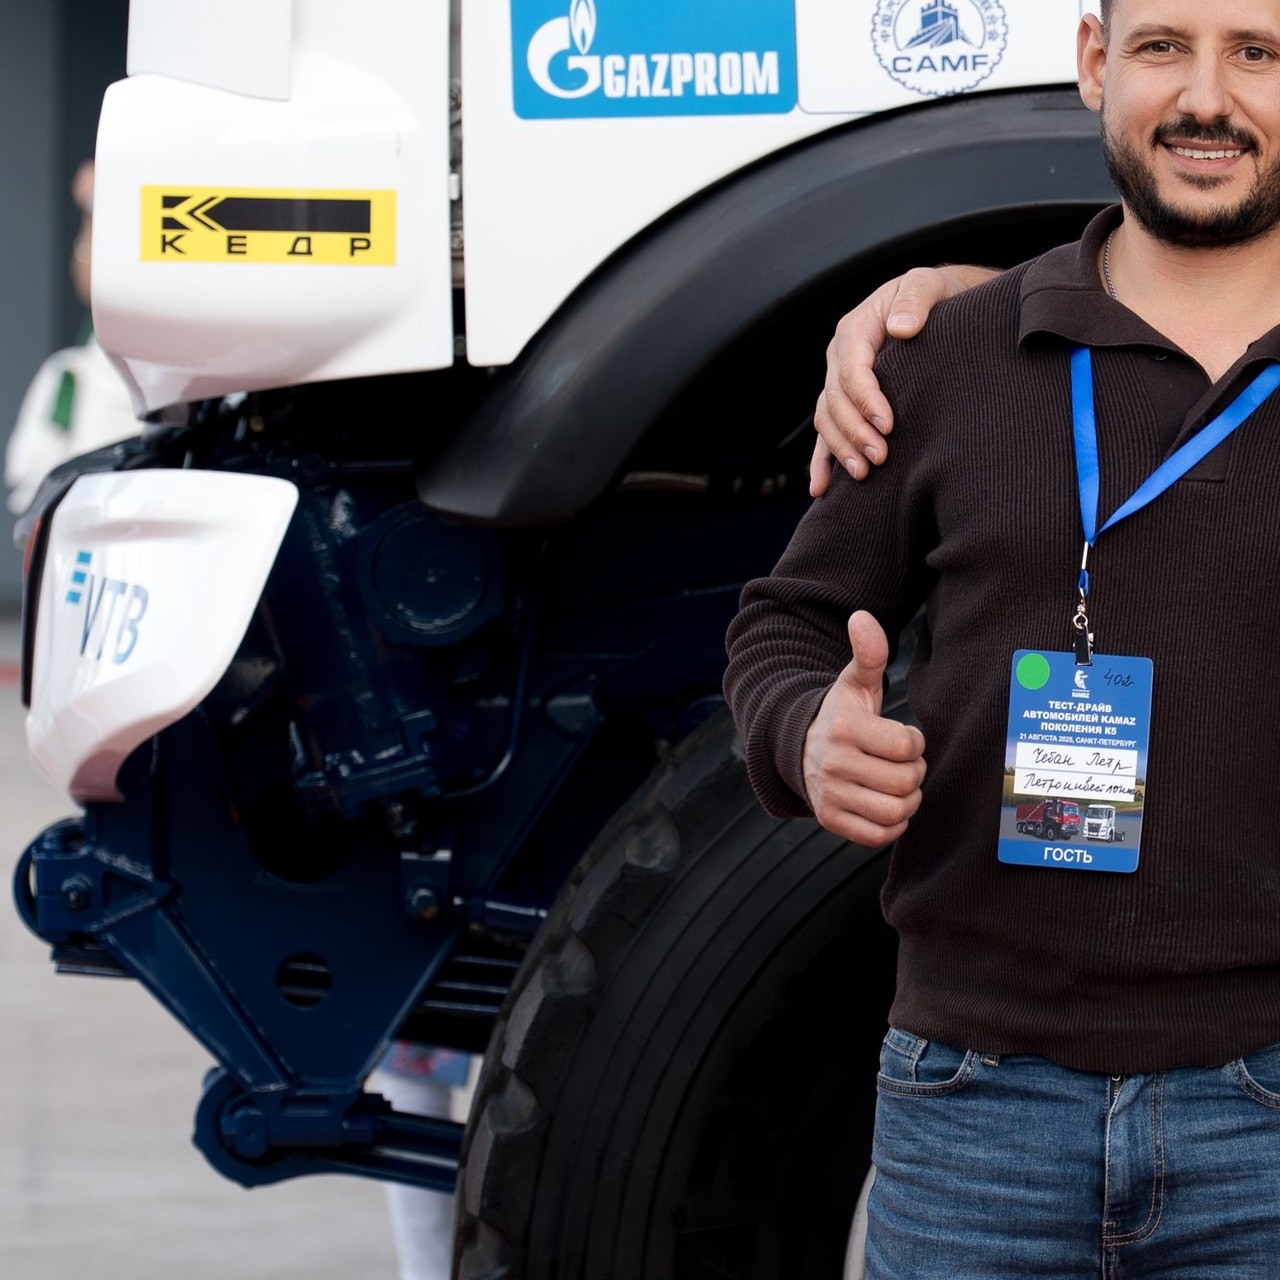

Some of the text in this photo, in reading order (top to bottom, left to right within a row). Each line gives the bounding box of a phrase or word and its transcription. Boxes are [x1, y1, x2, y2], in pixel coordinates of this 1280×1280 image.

[892, 54, 989, 73] CAMF
[602, 51, 779, 99] GAZPROM
[161, 234, 371, 257] КЕДР
[80, 574, 149, 665] VTB
[1048, 700, 1112, 713] ТЕСТ-ДРАЙВ
[1023, 710, 1099, 723] АВТОМОБИЛЕЙ
[1041, 722, 1117, 735] ПОКОЛЕНИЯ К5
[1028, 733, 1057, 742] АВГУСТА
[1075, 737, 1137, 747] САНКТ-ПЕТЕРБУРГ
[1044, 847, 1093, 863] ГОСТЬ
